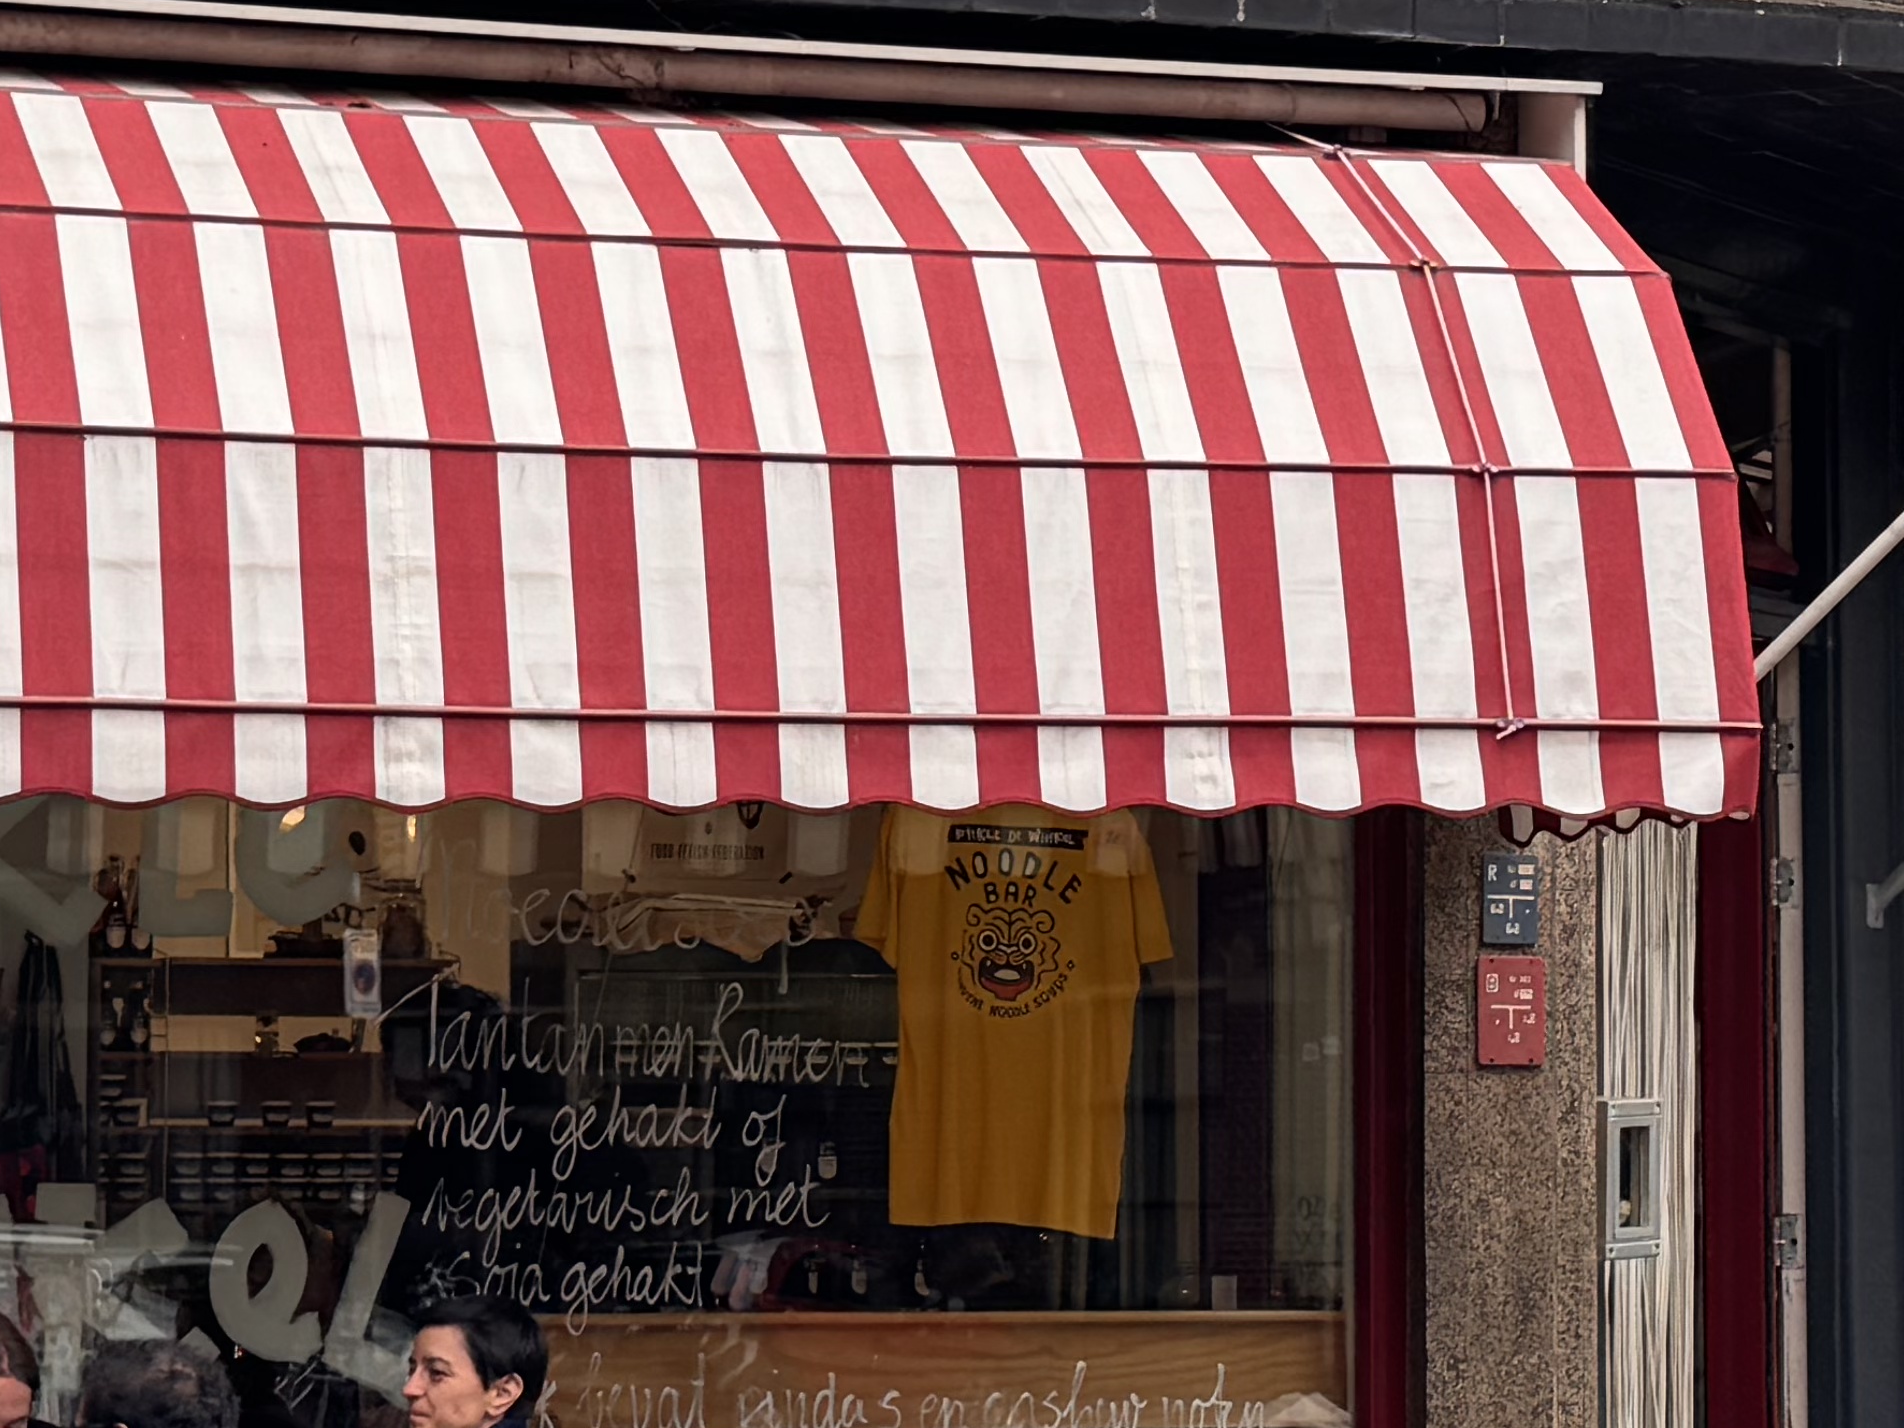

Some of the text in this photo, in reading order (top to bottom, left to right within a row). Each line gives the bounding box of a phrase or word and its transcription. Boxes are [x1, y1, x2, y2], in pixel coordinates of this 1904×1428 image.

[945, 847, 1082, 905] NOODLE
[983, 881, 1037, 907] BAR
[417, 1083, 788, 1187] met gehakt of
[422, 1164, 832, 1266] vegetarisch met
[559, 1240, 703, 1336] gehakt
